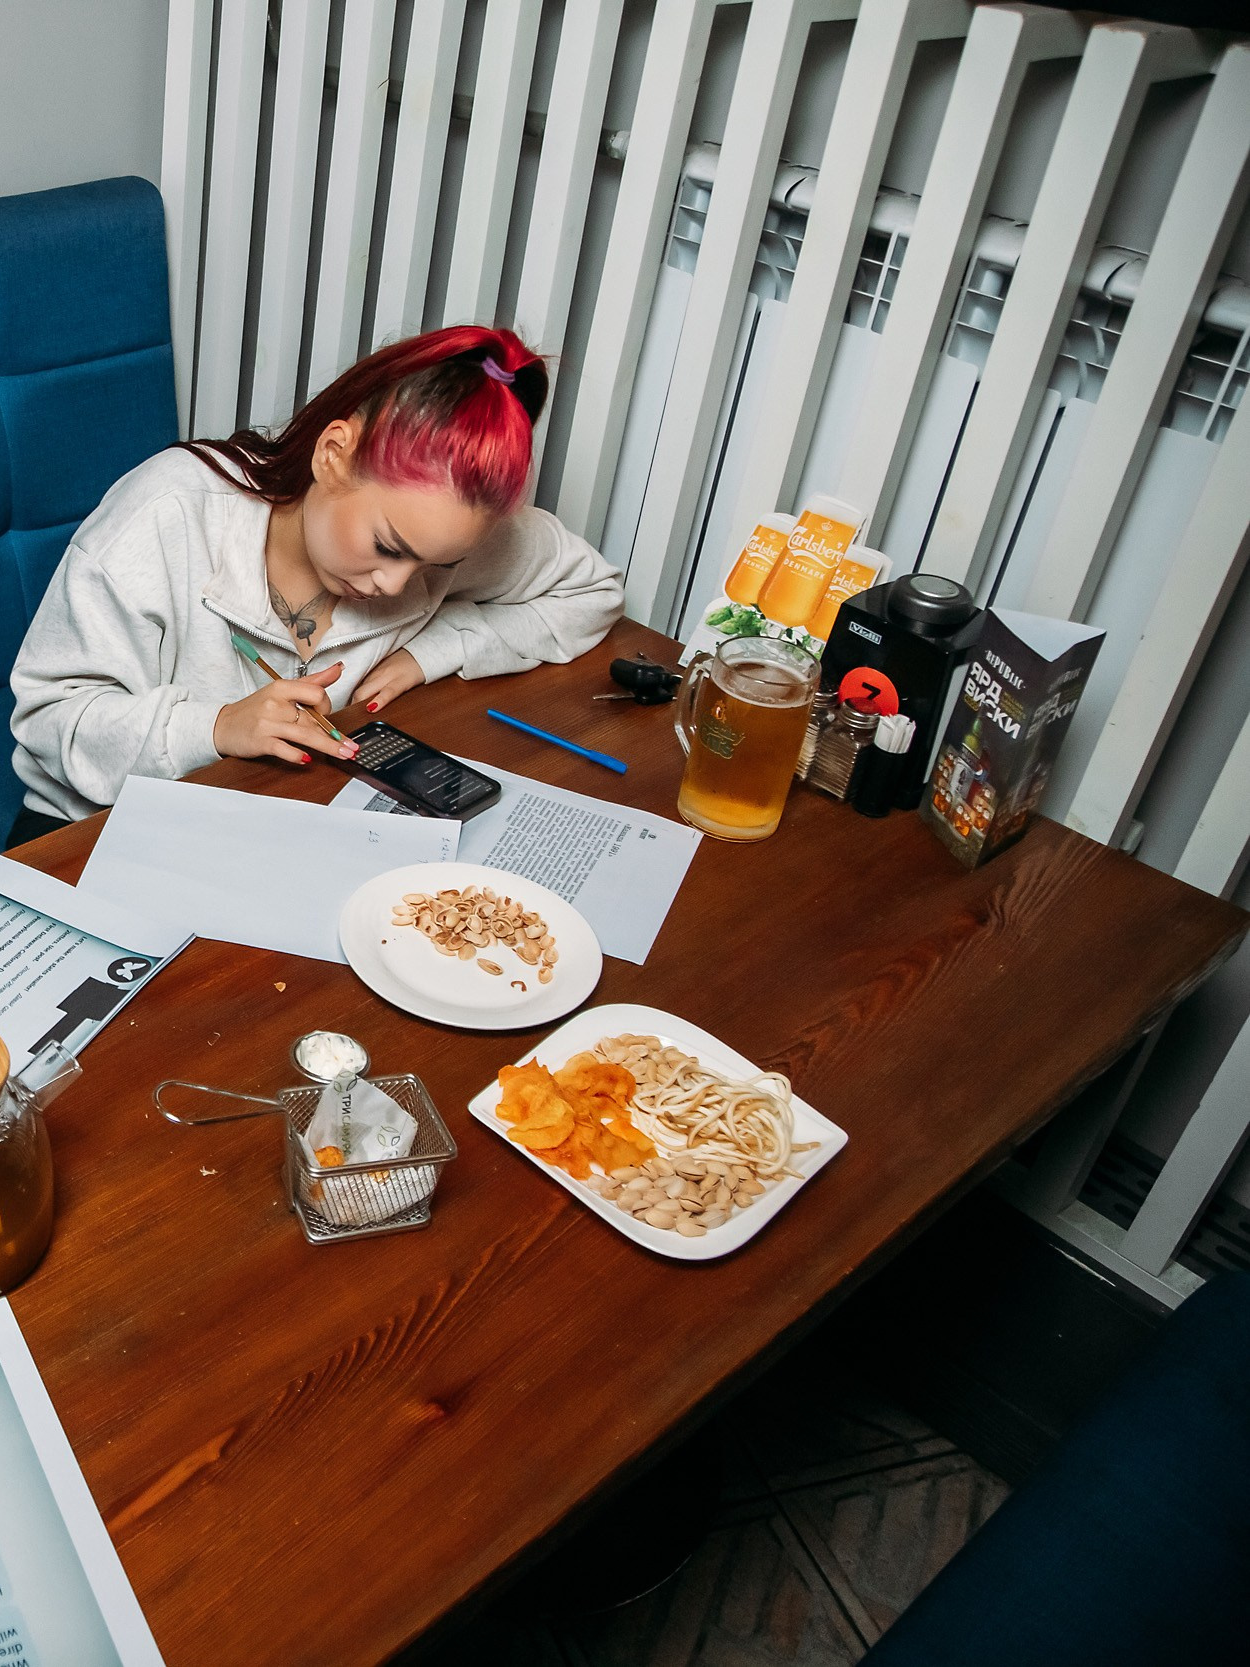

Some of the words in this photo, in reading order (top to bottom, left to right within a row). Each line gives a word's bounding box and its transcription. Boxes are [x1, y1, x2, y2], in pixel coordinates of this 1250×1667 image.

[745, 535, 779, 559] Carlsbe
[787, 525, 846, 566] Carlsberg
[783, 558, 826, 581] DENMARK
[970, 661, 1003, 704] ЯРД
[985, 650, 1025, 690] REPUBLIC
[55, 955, 65, 963] the
